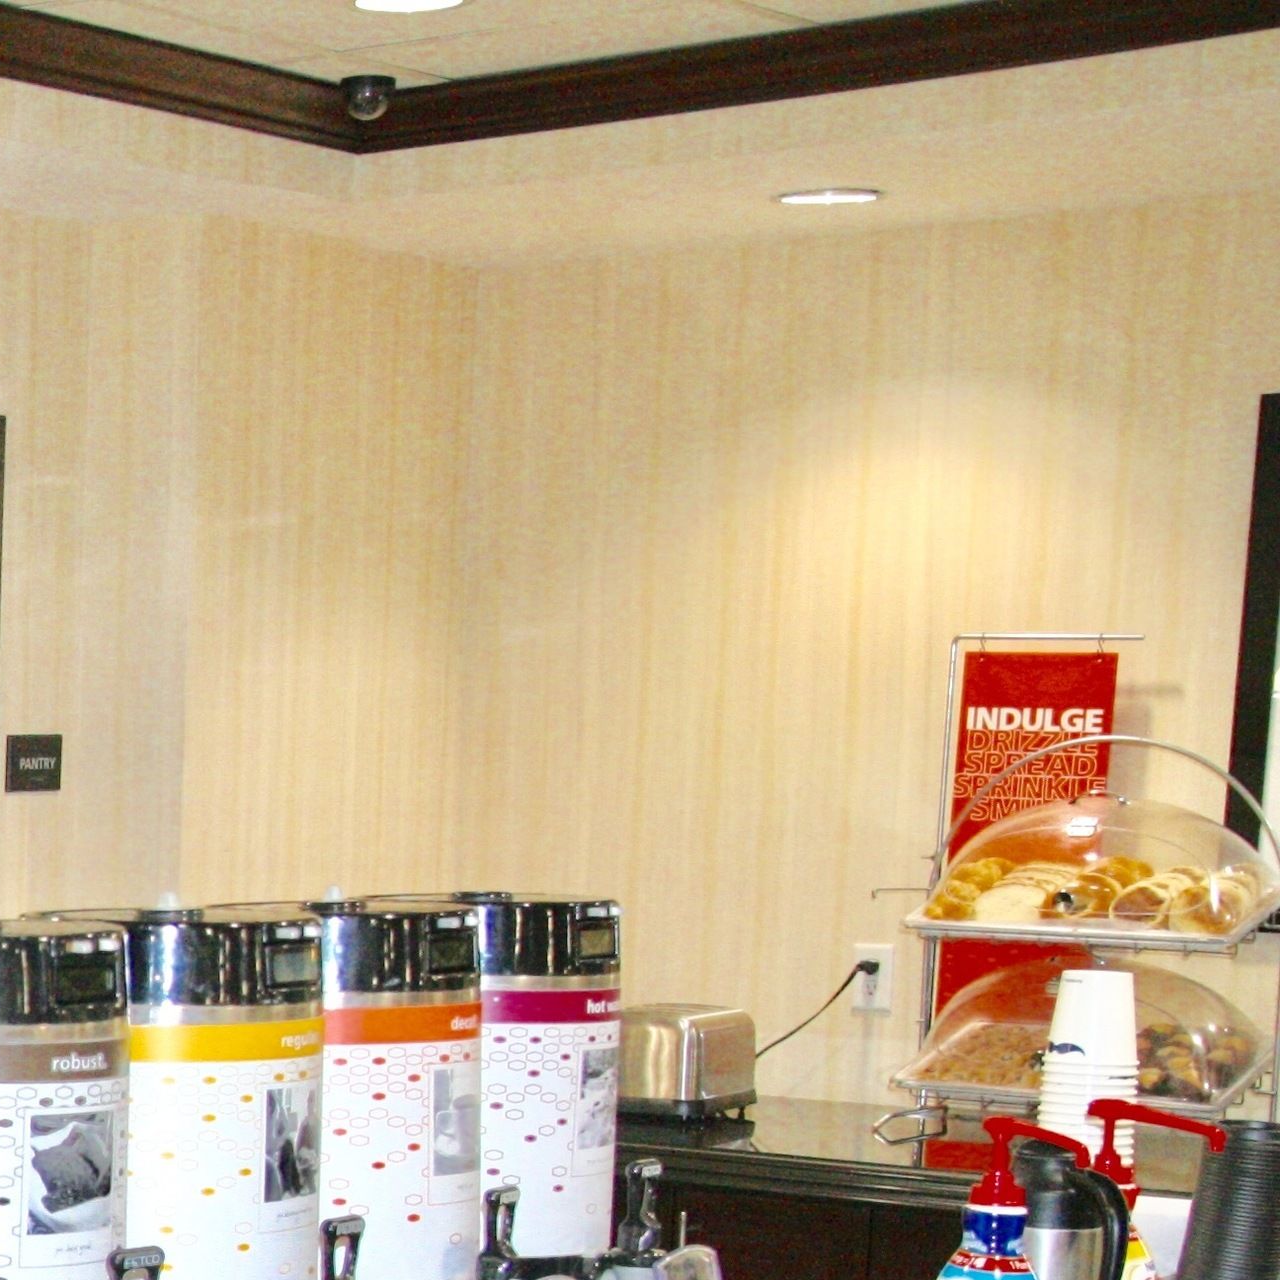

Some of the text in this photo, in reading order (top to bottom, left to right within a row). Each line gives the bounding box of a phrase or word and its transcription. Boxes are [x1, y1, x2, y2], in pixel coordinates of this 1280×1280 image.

[966, 706, 1104, 733] INDULGE
[966, 729, 1098, 756] DRIZZLE
[19, 757, 56, 770] PANTRY
[964, 751, 1097, 777] SPREAD
[586, 999, 606, 1015] hot
